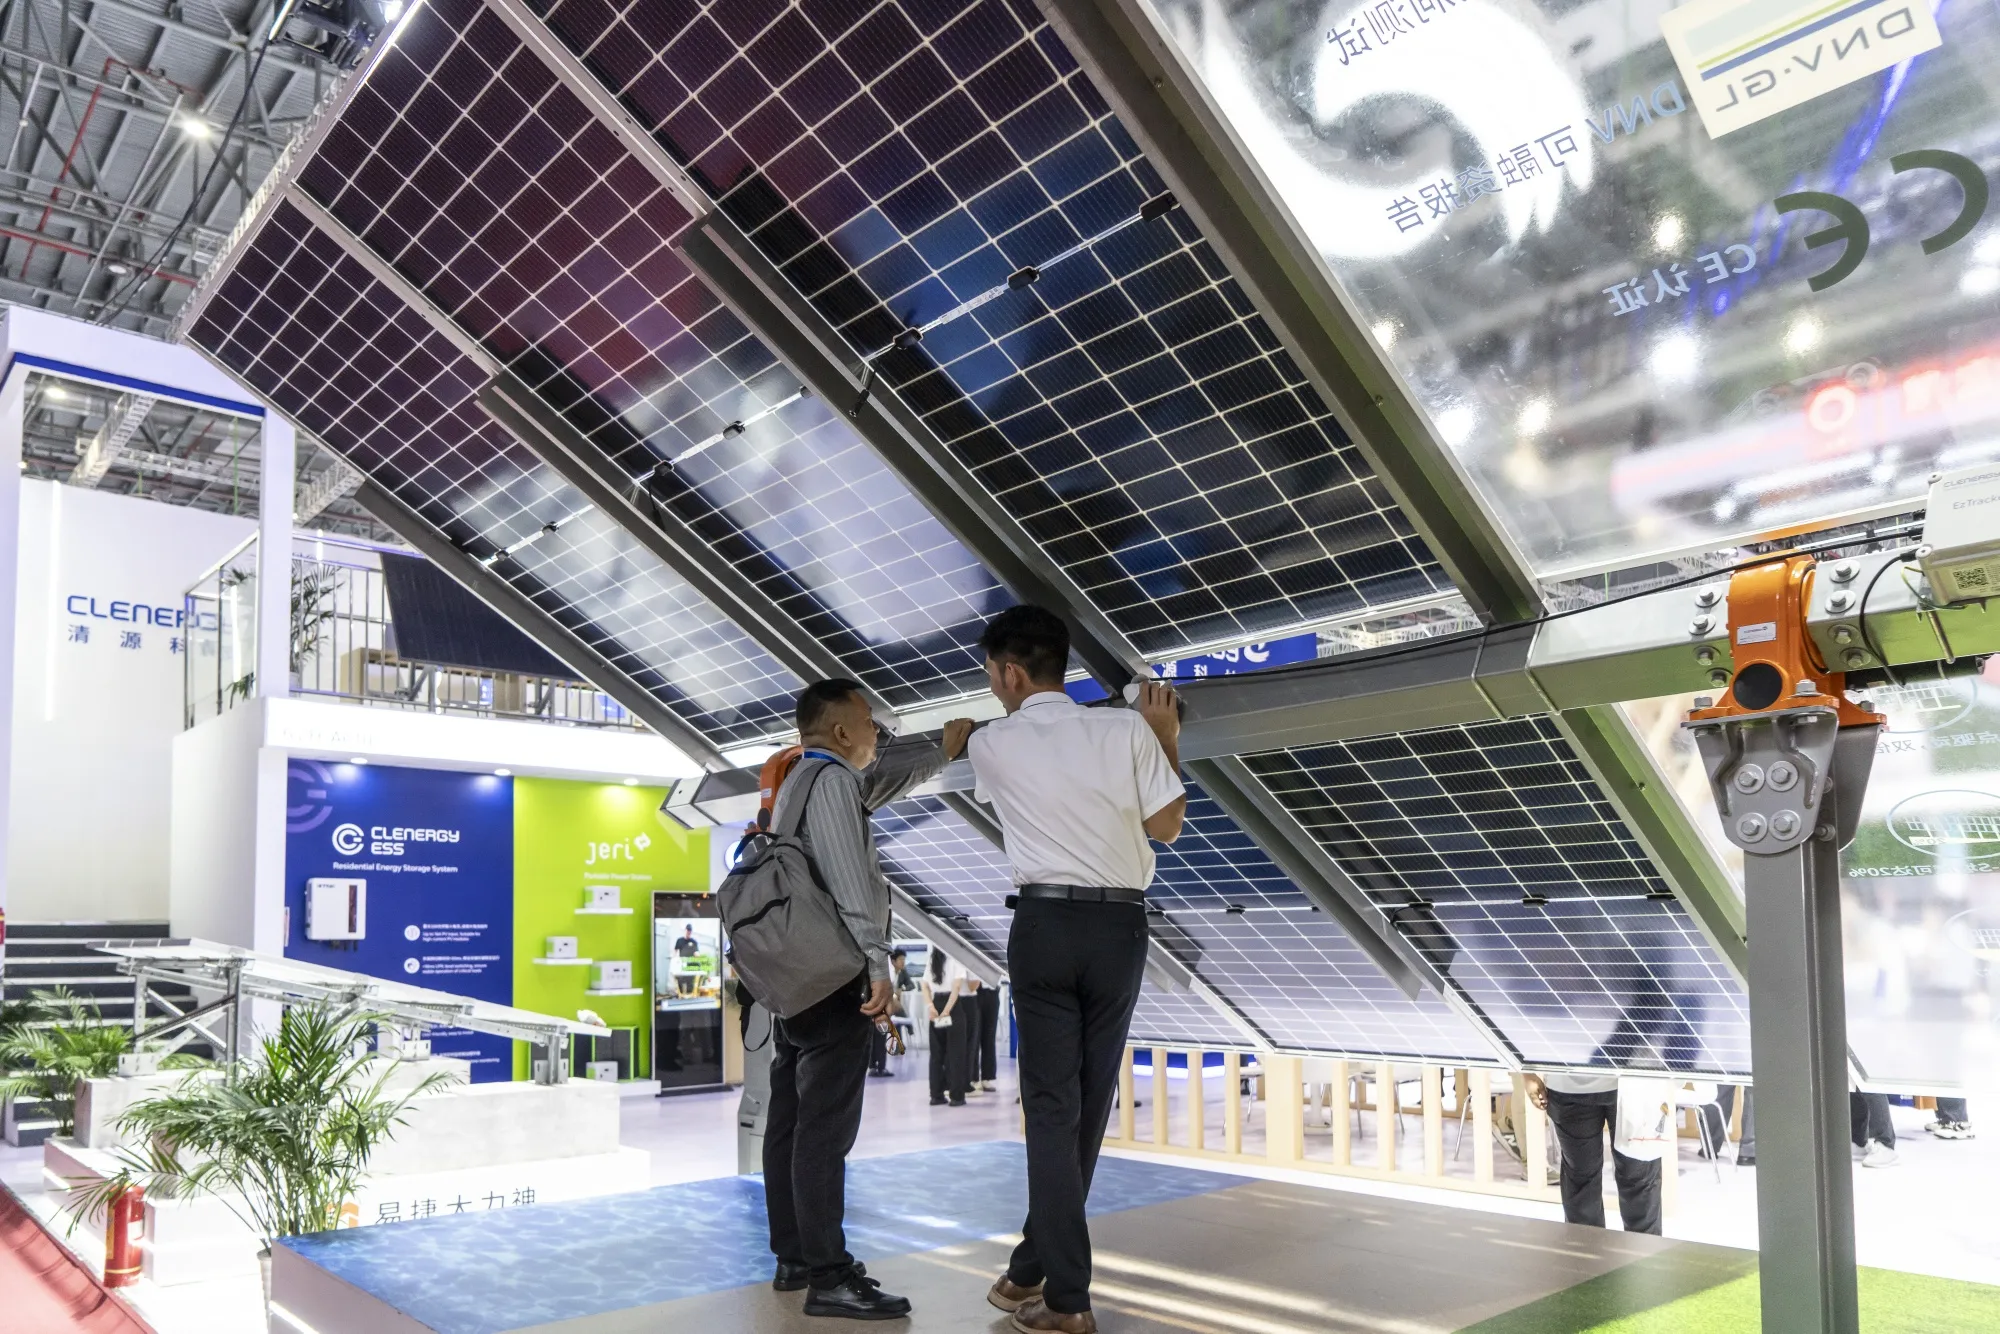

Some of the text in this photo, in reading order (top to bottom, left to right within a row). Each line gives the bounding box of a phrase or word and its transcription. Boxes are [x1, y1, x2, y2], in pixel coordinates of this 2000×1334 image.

[68, 624, 217, 657] 清源科
[371, 826, 460, 843] CLENERGY
[371, 842, 405, 855] ESS
[333, 861, 458, 874] Residential Energy Storage System
[375, 1186, 535, 1224] 易捷大力神
